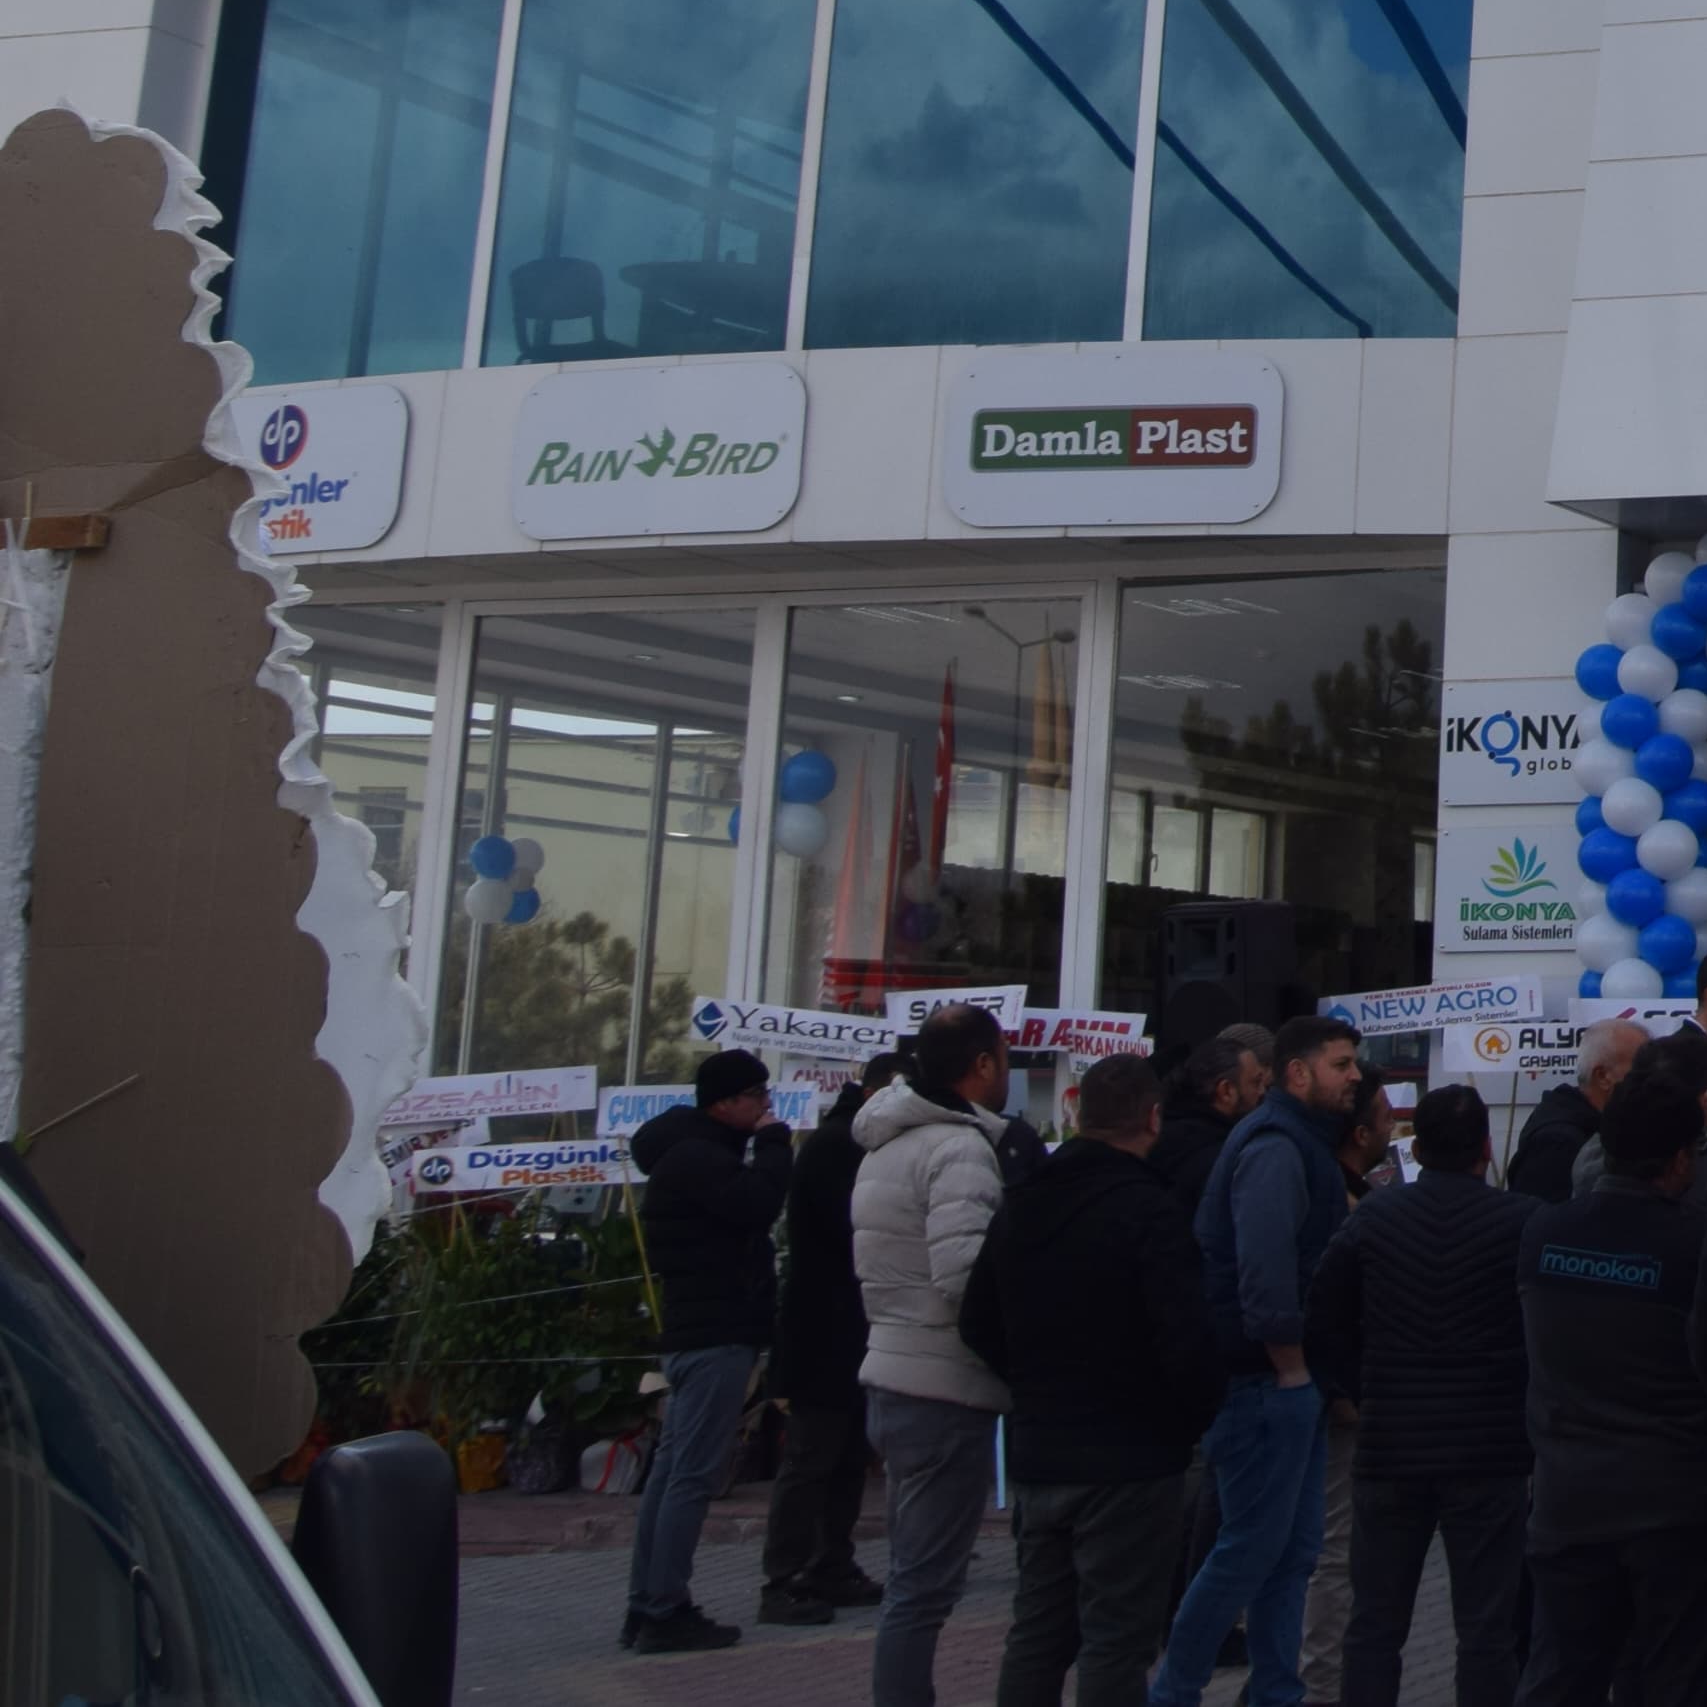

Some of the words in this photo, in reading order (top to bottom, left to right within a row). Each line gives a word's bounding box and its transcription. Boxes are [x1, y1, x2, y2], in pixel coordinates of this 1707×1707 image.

[981, 420, 1123, 457] Damla
[1136, 418, 1248, 454] Plast
[1463, 926, 1508, 941] Sulama
[1512, 924, 1573, 940] Sistemleri
[1360, 996, 1425, 1021] NEW
[1435, 986, 1518, 1013] AGRO
[730, 1004, 895, 1045] Yakarer
[502, 1167, 606, 1186] Plastik
[1544, 1253, 1656, 1287] monokon
